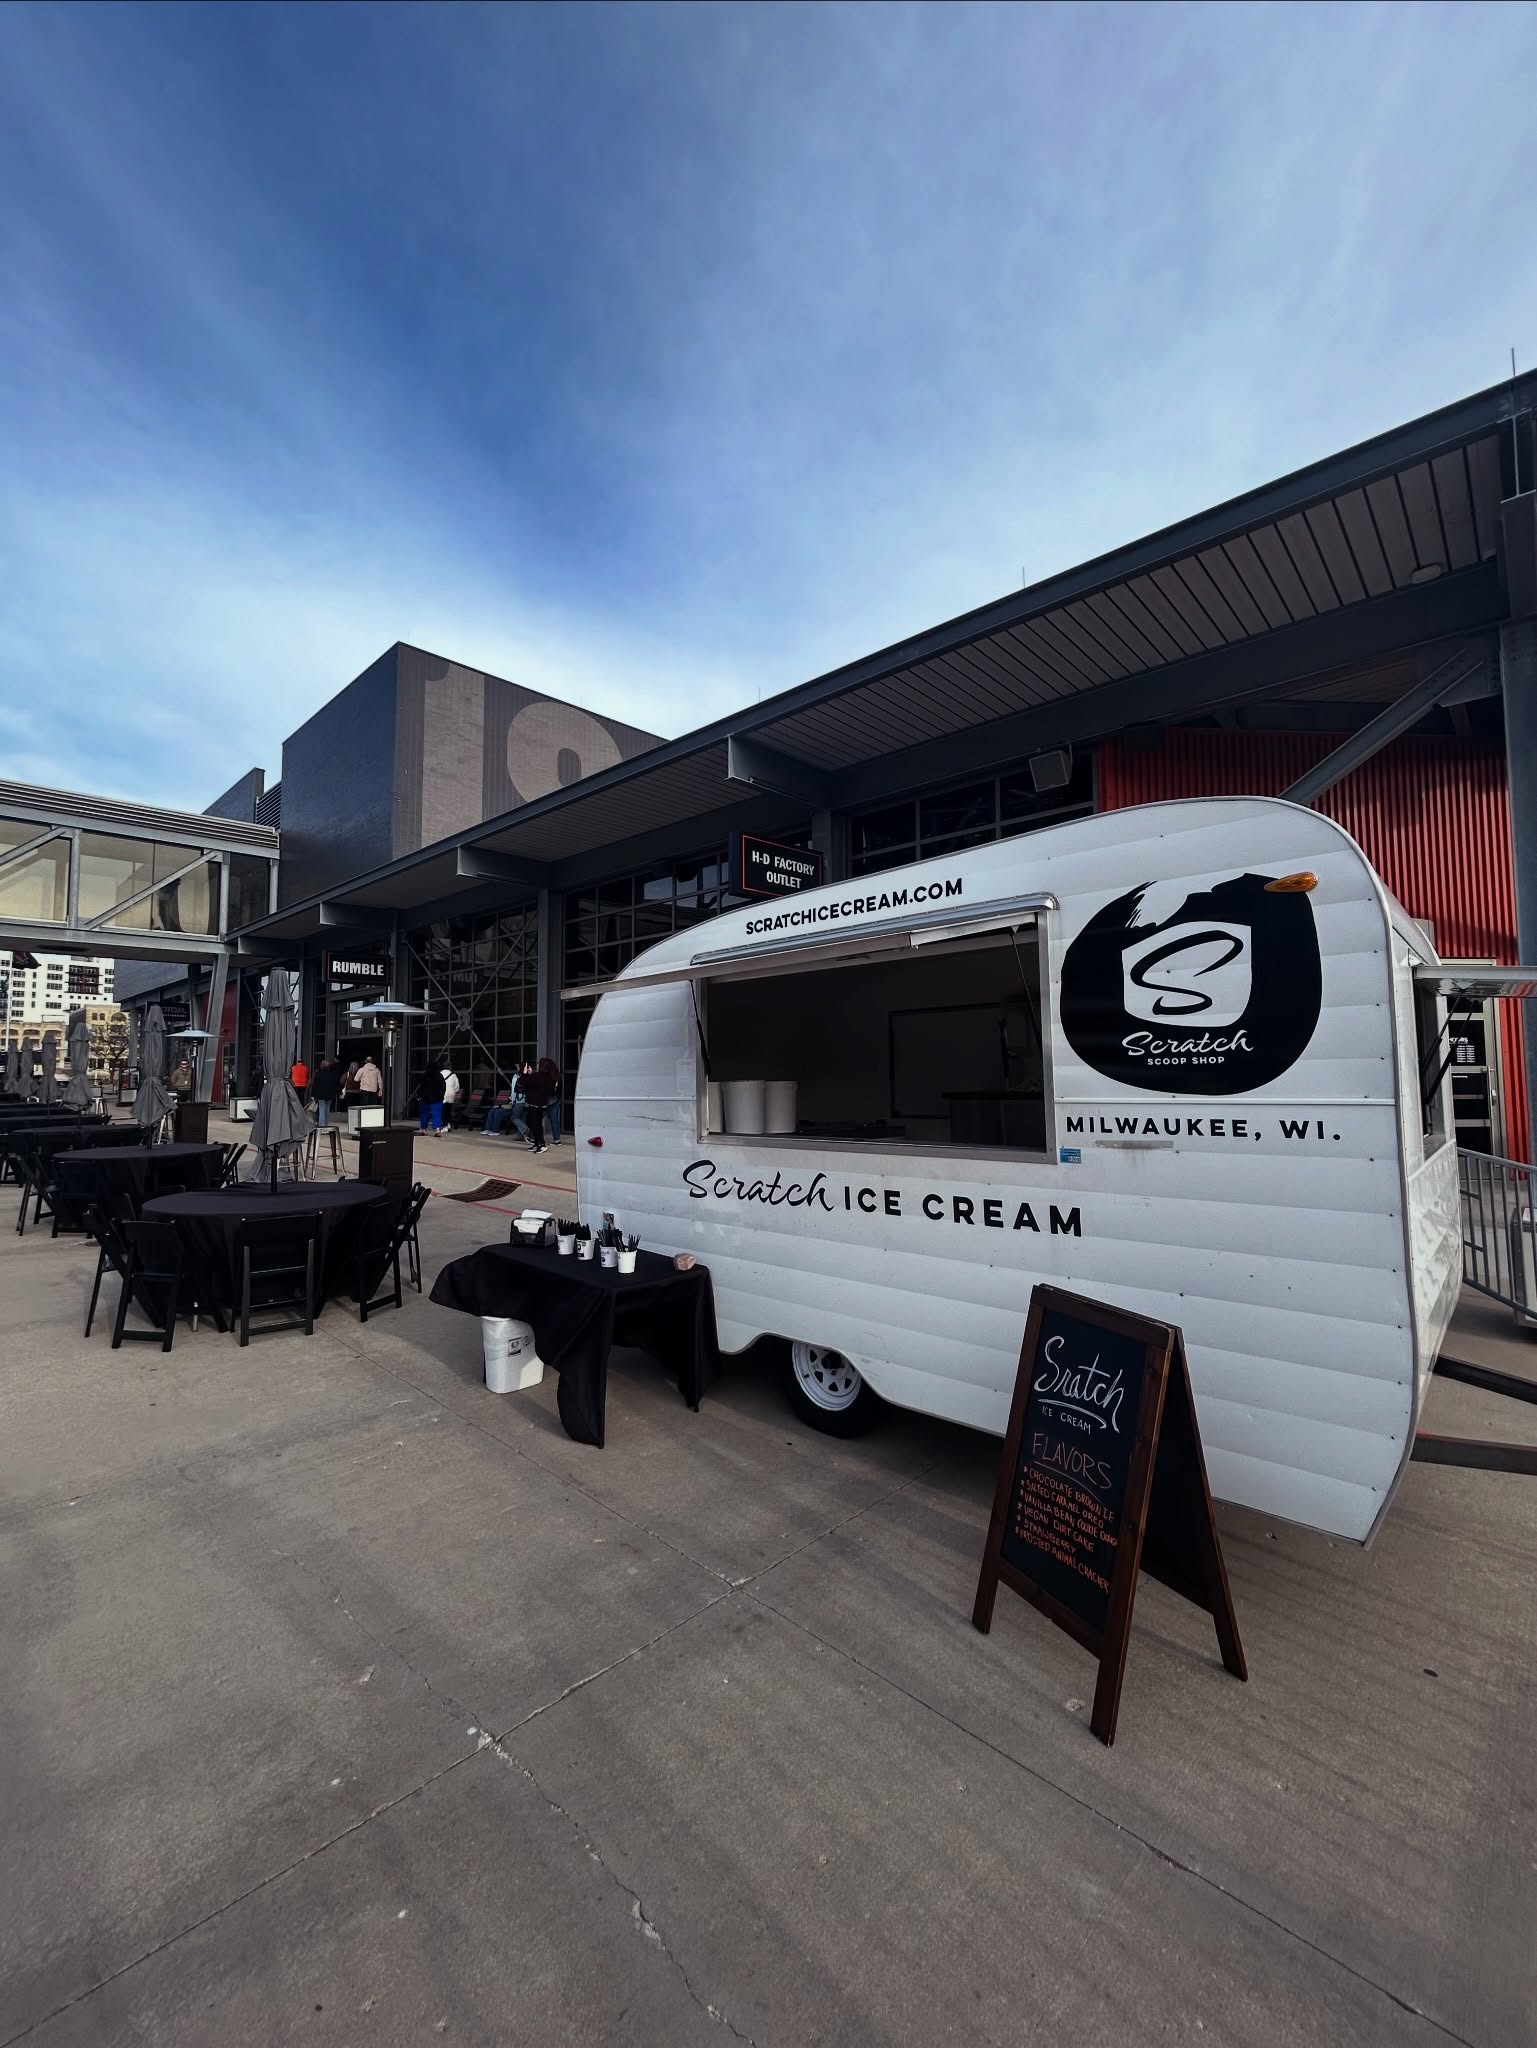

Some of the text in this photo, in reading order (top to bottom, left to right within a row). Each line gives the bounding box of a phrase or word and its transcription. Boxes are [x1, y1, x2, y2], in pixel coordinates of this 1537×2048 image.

[752, 850, 815, 876] H-D FACTORY
[766, 871, 802, 889] OUTLET
[745, 877, 963, 935] SCRATCHICECREAM.COM
[332, 960, 386, 977] RUMBLE
[1121, 1029, 1254, 1056] Scratch
[1147, 1056, 1226, 1067] SCOOP SHOP
[1066, 1116, 1342, 1141] MILWAUKEE, WI.
[682, 1158, 1083, 1238] Scratch ICE CREAM
[1041, 1405, 1092, 1435] ICE CREAM
[1032, 1431, 1112, 1489] FLAVORS
[1026, 1481, 1105, 1529] SALTED CARAMEL OREO
[1029, 1468, 1115, 1523] CHOCOLATE BROWNIE
[1024, 1493, 1052, 1513] VANILLA
[1054, 1506, 1075, 1528] BEAN
[1077, 1518, 1098, 1538] COOKIE
[1024, 1505, 1095, 1552] VEGAN DIRT CAKE
[1020, 1529, 1051, 1551] FROSTED
[1052, 1547, 1077, 1569] ANIMAL
[1023, 1518, 1076, 1553] STRAWBERRY
